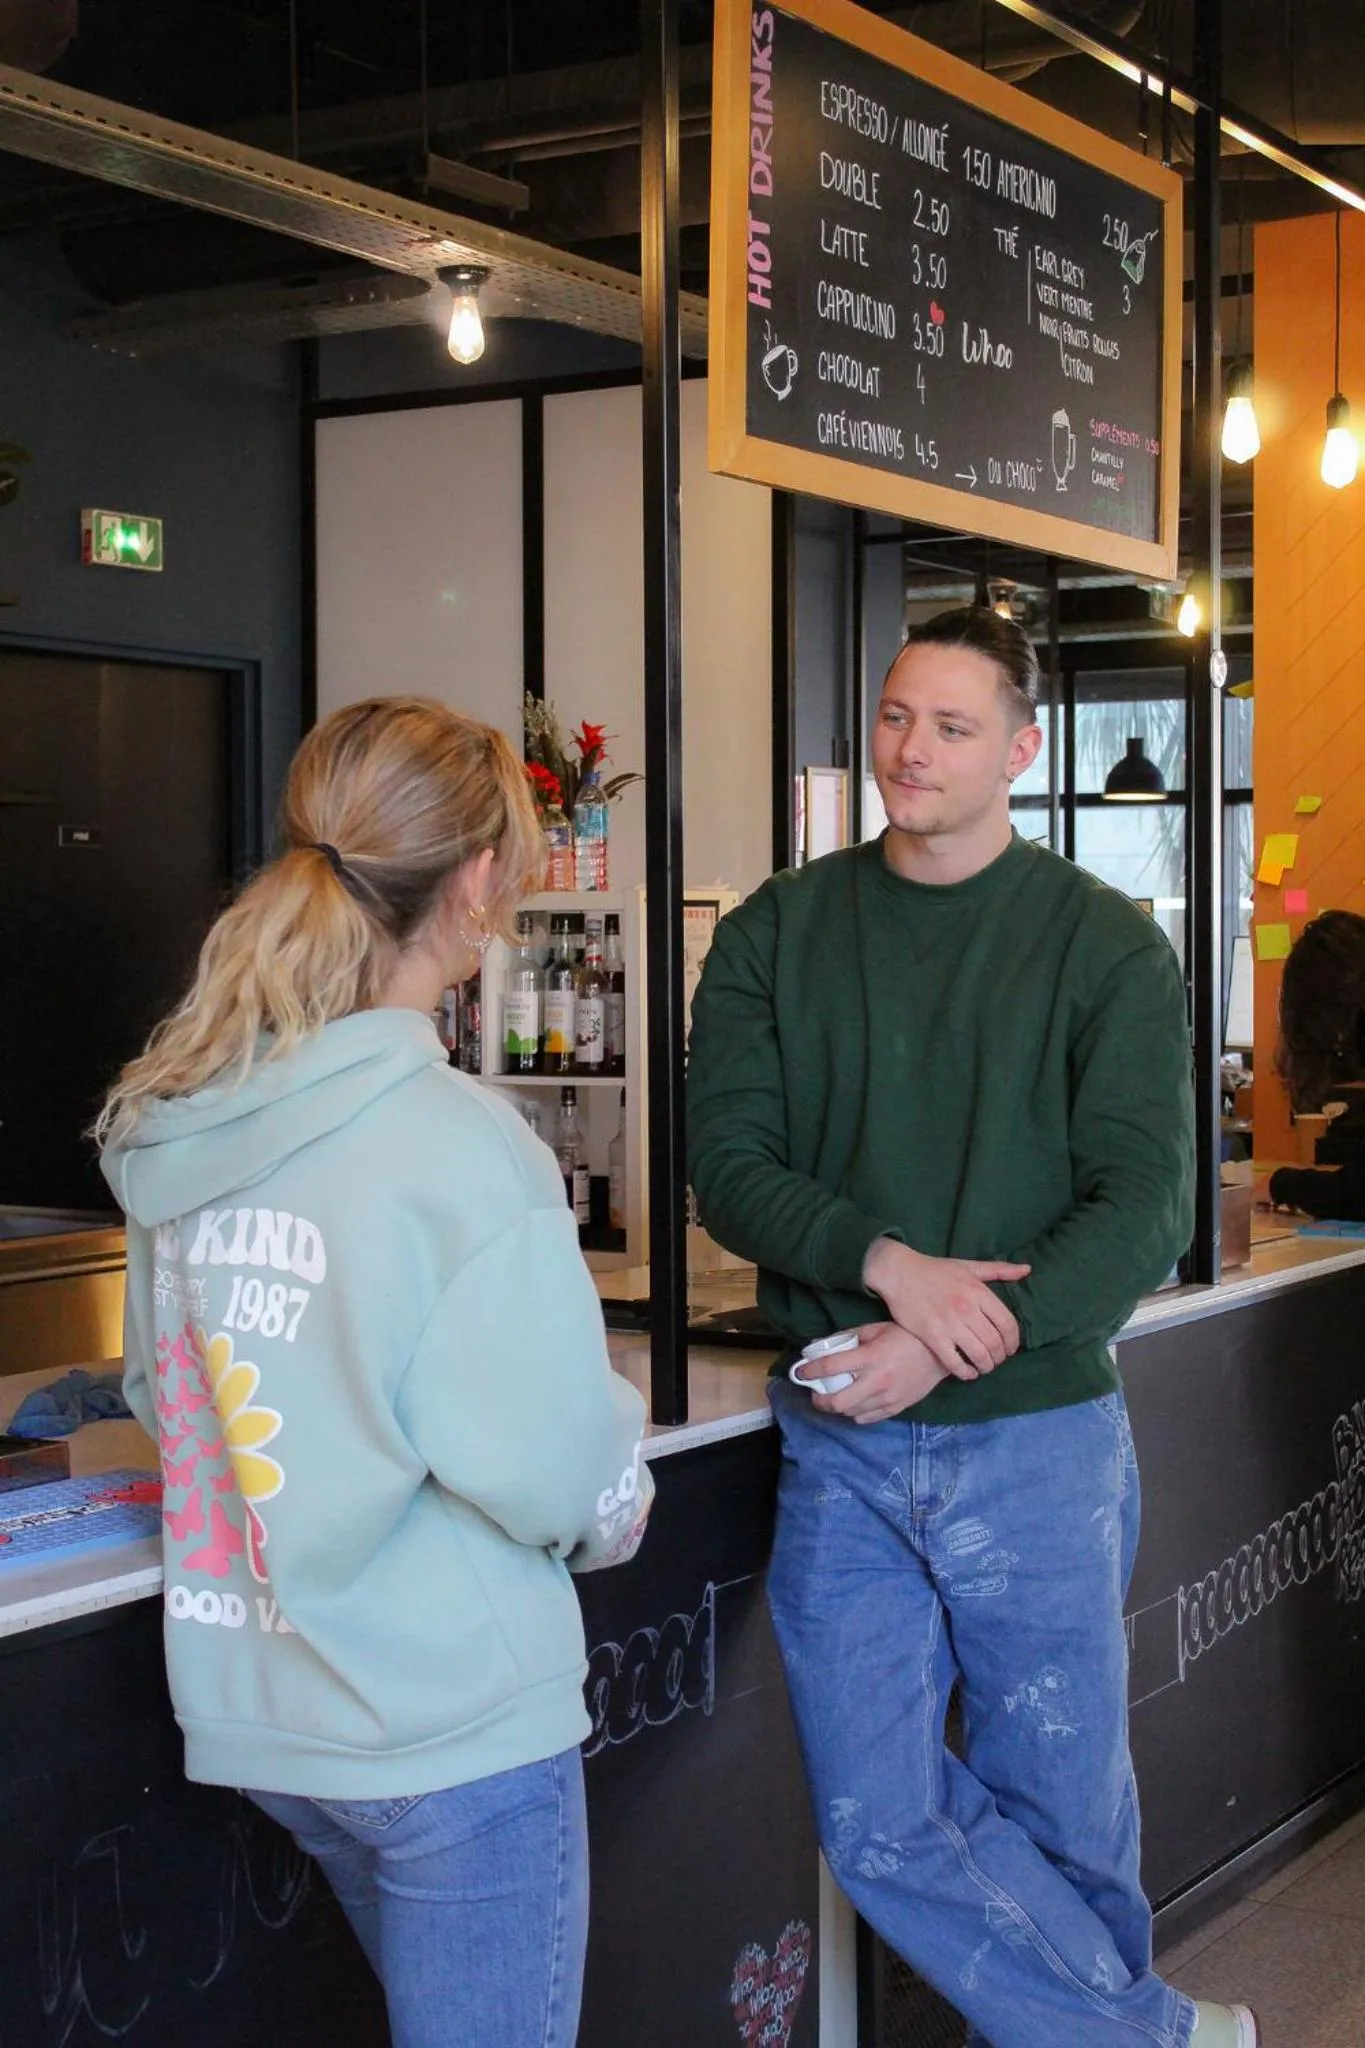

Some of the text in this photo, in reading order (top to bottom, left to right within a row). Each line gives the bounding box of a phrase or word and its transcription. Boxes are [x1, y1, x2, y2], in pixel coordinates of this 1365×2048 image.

[748, 10, 774, 309] HOT DRINKS
[821, 81, 888, 143] ESPRESSO
[902, 118, 949, 172] ALLONGÉ
[963, 146, 991, 189] 1.50
[820, 152, 949, 236] DOUBLE 2.50
[997, 159, 1056, 219] AMERICANO
[821, 218, 947, 289] LATTE 3.50
[993, 226, 1131, 315] THÉ 3
[1034, 245, 1084, 290] EARL GREY
[817, 280, 944, 357] CAPPUCCINO 3.50
[1036, 282, 1058, 310] VERT
[818, 351, 927, 405] CHOCOLAT 4
[1063, 352, 1094, 386] CITRON
[818, 410, 939, 469] CAFÉ VIENNOIS 4.5
[988, 457, 1002, 485] OU
[187, 1207, 327, 1285] KIND
[222, 1275, 310, 1343] 1987
[165, 1585, 247, 1628] OOD
